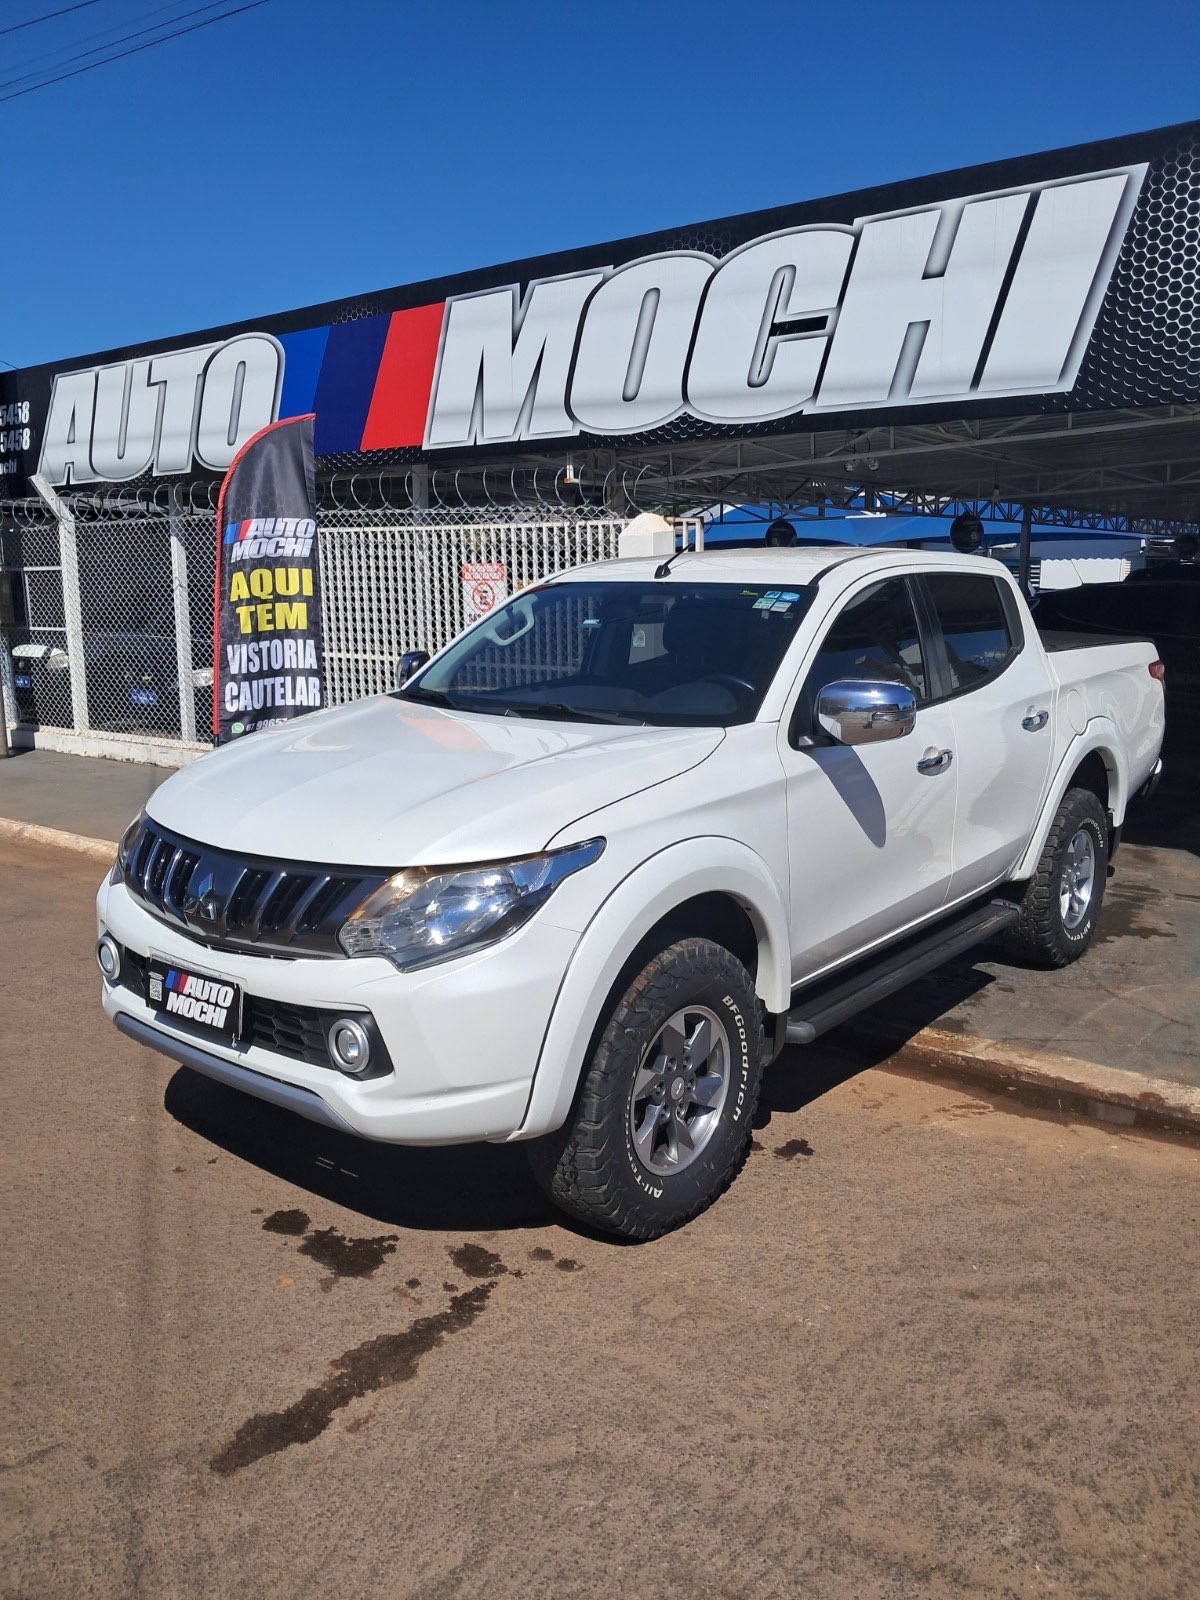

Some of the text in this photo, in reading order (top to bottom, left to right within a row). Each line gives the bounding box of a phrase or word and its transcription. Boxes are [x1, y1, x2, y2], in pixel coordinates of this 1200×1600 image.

[37, 162, 1148, 486] AUTO MOCHI
[245, 518, 316, 539] AUTO
[231, 537, 313, 563] MOCHI
[230, 567, 313, 602] AQUI
[236, 602, 308, 634] TEM
[226, 638, 318, 674] VISTORIA
[225, 676, 321, 712] CAUTELAR
[183, 975, 235, 1008] AUTO
[166, 991, 228, 1029] MOCHI
